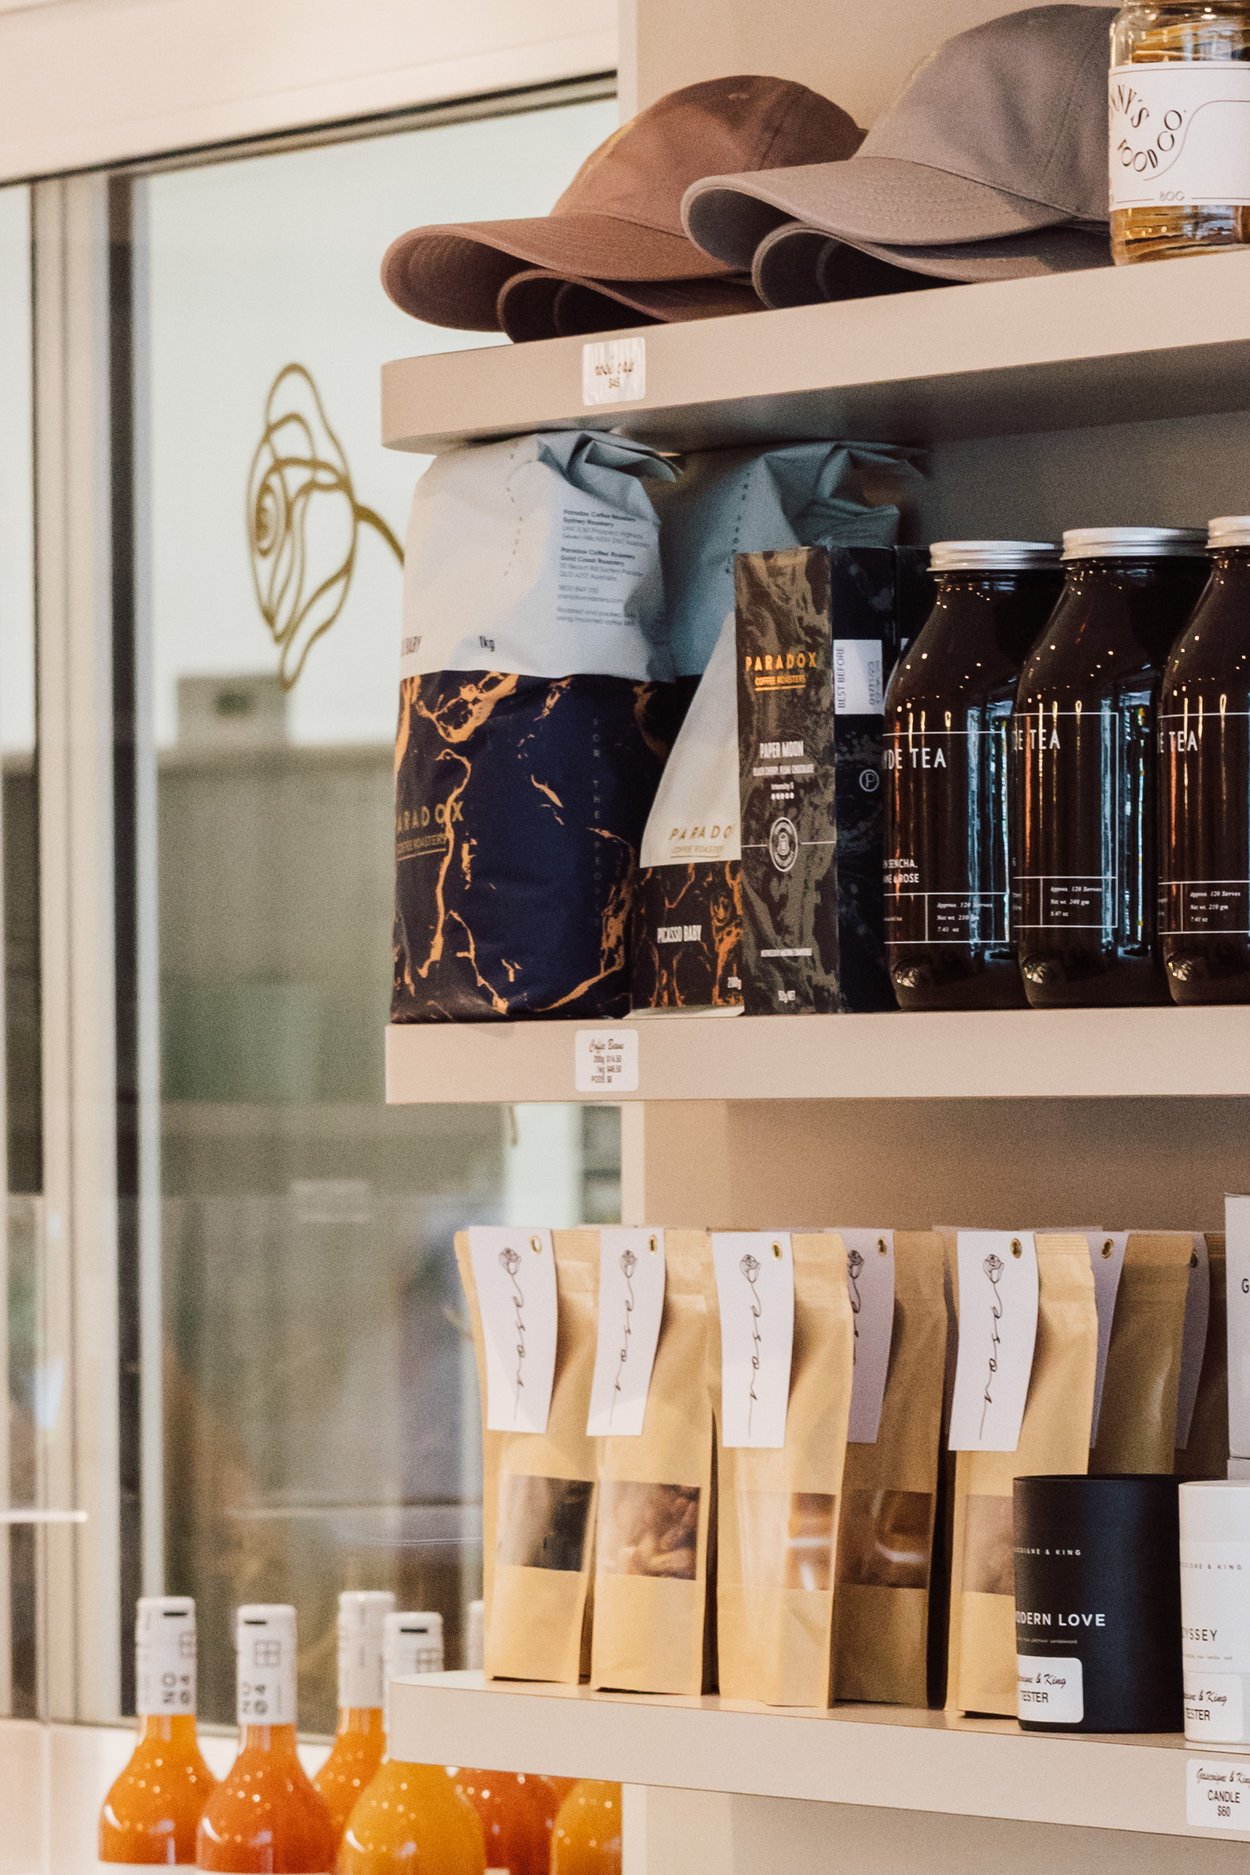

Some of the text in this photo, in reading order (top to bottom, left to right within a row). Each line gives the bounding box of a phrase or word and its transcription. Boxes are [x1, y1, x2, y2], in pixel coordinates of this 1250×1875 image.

[1117, 138, 1159, 173] FOOD
[479, 635, 495, 652] 1kg
[745, 651, 818, 672] PARADOX
[754, 675, 778, 686] COFFEE
[834, 647, 847, 709] BEST BEFORE
[1030, 728, 1061, 750] TEA
[1169, 730, 1199, 752] TEA
[759, 740, 804, 759] PAPER MOON
[911, 748, 947, 769] TEA
[900, 873, 920, 884] ROSE
[657, 924, 703, 944] PICASSO BABY
[1055, 1548, 1082, 1556] KING
[1217, 1563, 1243, 1571] KING
[1058, 1613, 1106, 1627] LOVE
[1036, 1672, 1067, 1690] & King
[1020, 1690, 1050, 1704] TESTER
[1199, 1690, 1228, 1706] & King
[1186, 1707, 1211, 1721] TESTER
[1229, 1770, 1235, 1782] &
[1207, 1789, 1241, 1803] CANDLE
